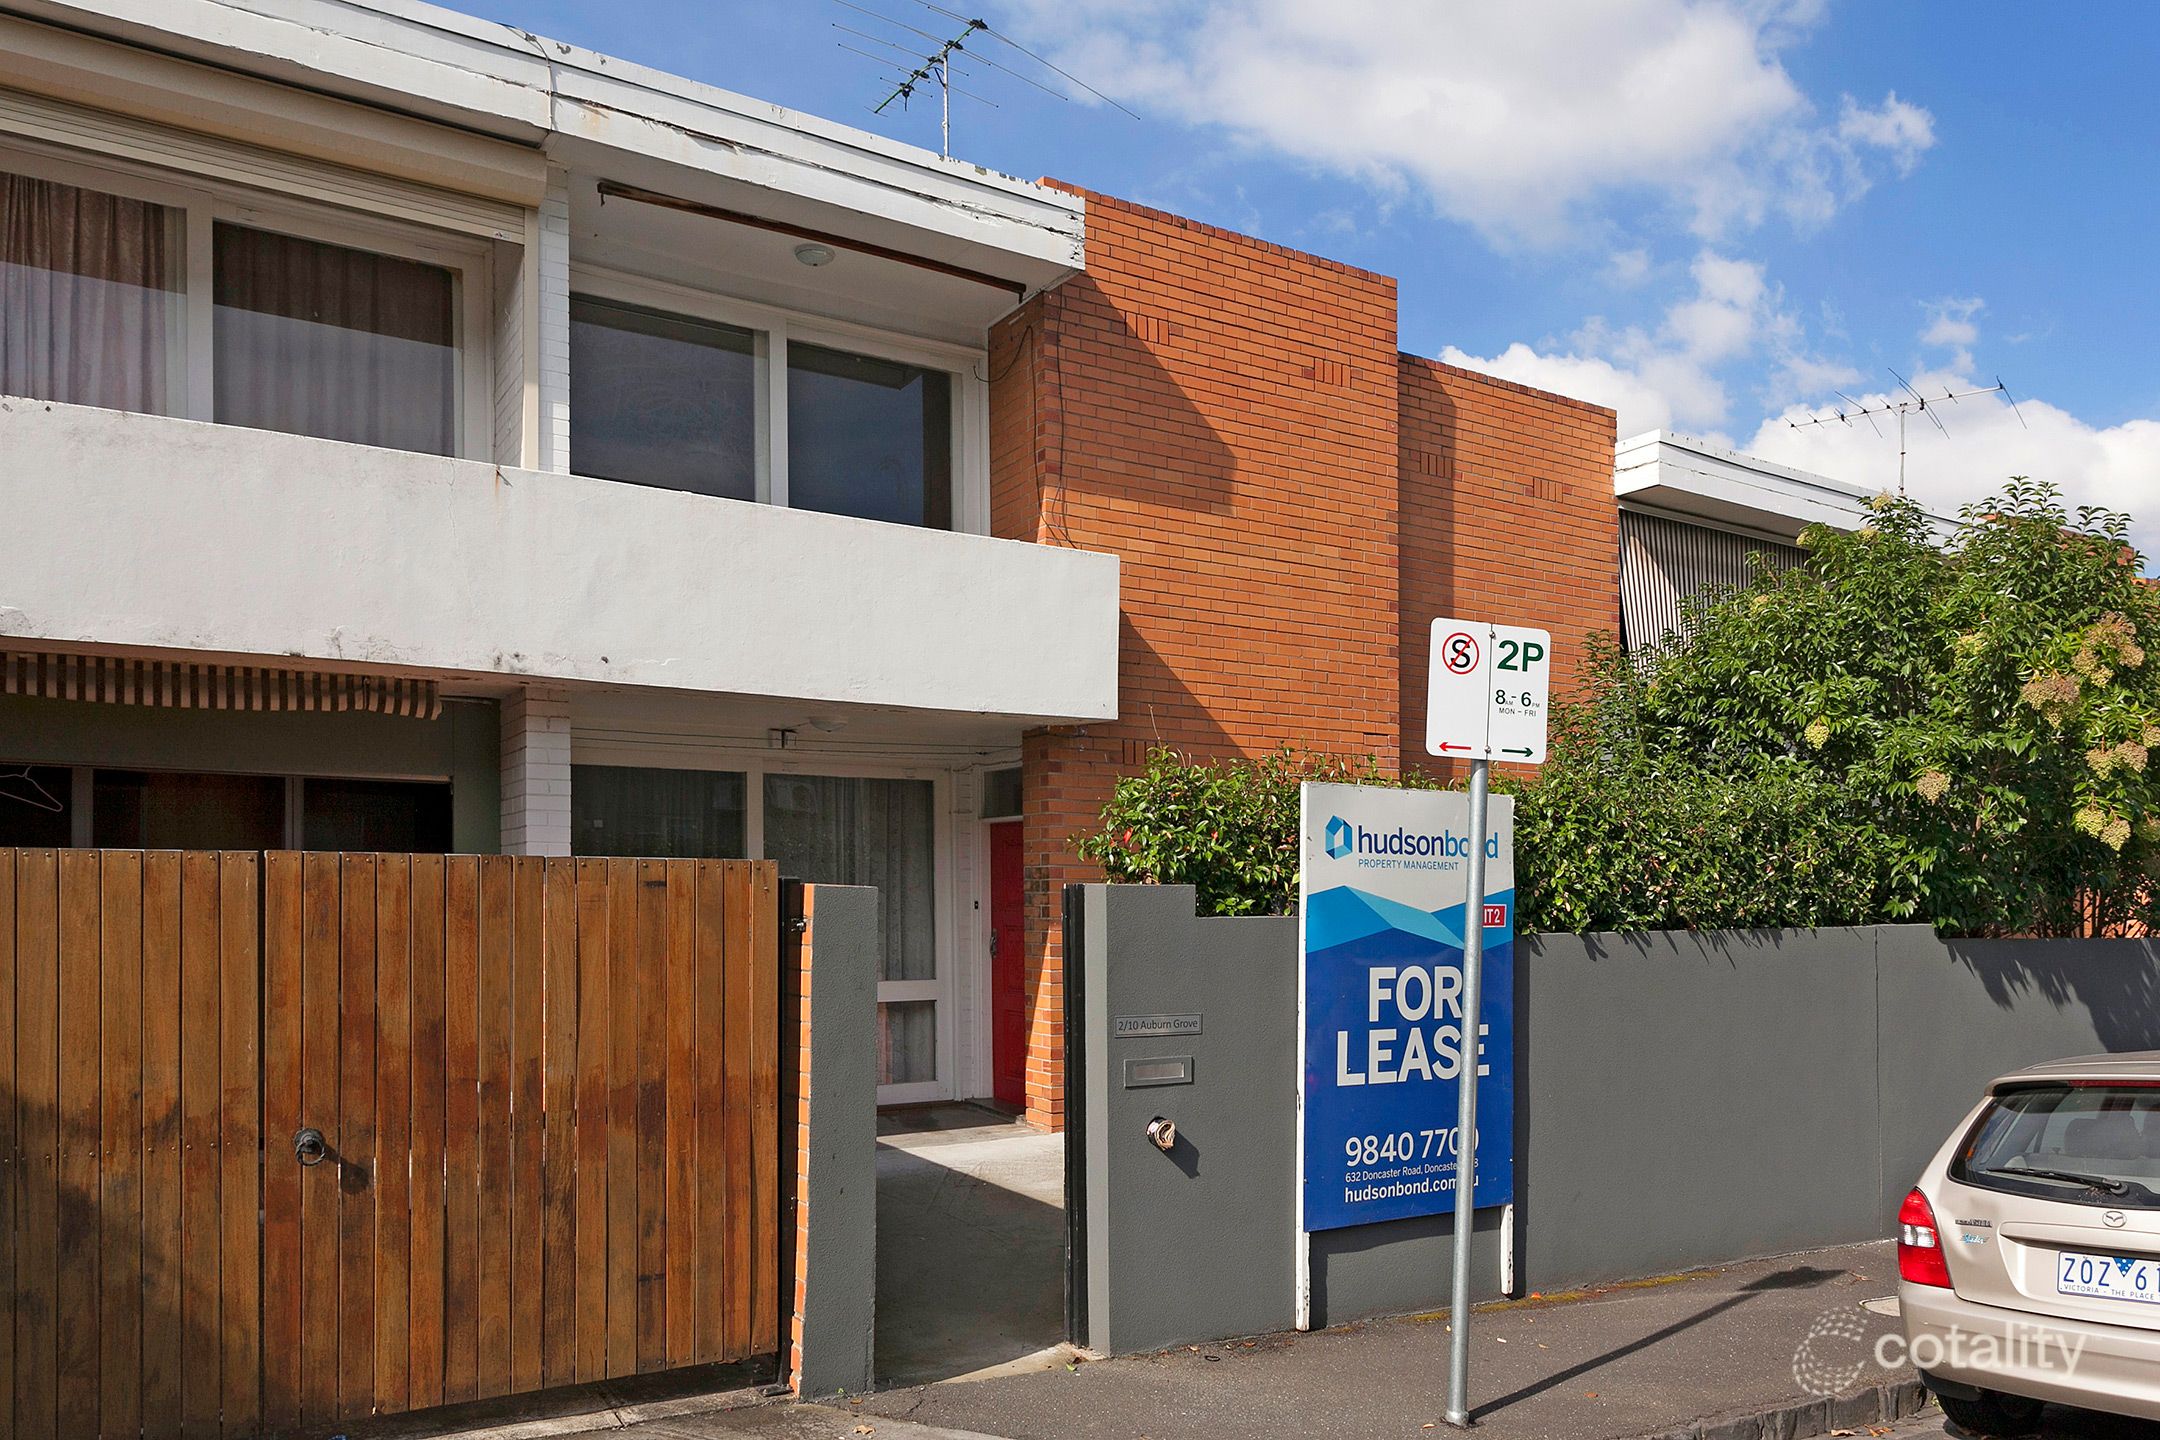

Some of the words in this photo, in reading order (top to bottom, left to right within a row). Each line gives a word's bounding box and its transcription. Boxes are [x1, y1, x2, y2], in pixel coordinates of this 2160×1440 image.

[1497, 640, 1544, 672] 2P
[1499, 707, 1515, 715] MON
[1524, 709, 1537, 717] FRI
[1358, 825, 1498, 859] hudsonbod
[1358, 858, 1402, 869] PROPERTY
[1403, 860, 1459, 871] MANAGEMENT
[1484, 908, 1500, 923] IT2
[1369, 965, 1463, 1022] FOR
[1118, 1020, 1139, 1032] 2/10
[1140, 1020, 1172, 1030] Auburn
[1173, 1019, 1198, 1028] Grove
[1345, 1132, 1414, 1167] 9840
[1345, 1173, 1361, 1182] 632
[1362, 1168, 1401, 1181] Doncaster
[1424, 1161, 1457, 1174] Doncaste
[1345, 1174, 1479, 1203] hudsonbond.comu
[2063, 1284, 2099, 1294] VICTORIA
[2111, 1289, 2126, 1297] THE
[2130, 1291, 2155, 1301] PLACE
